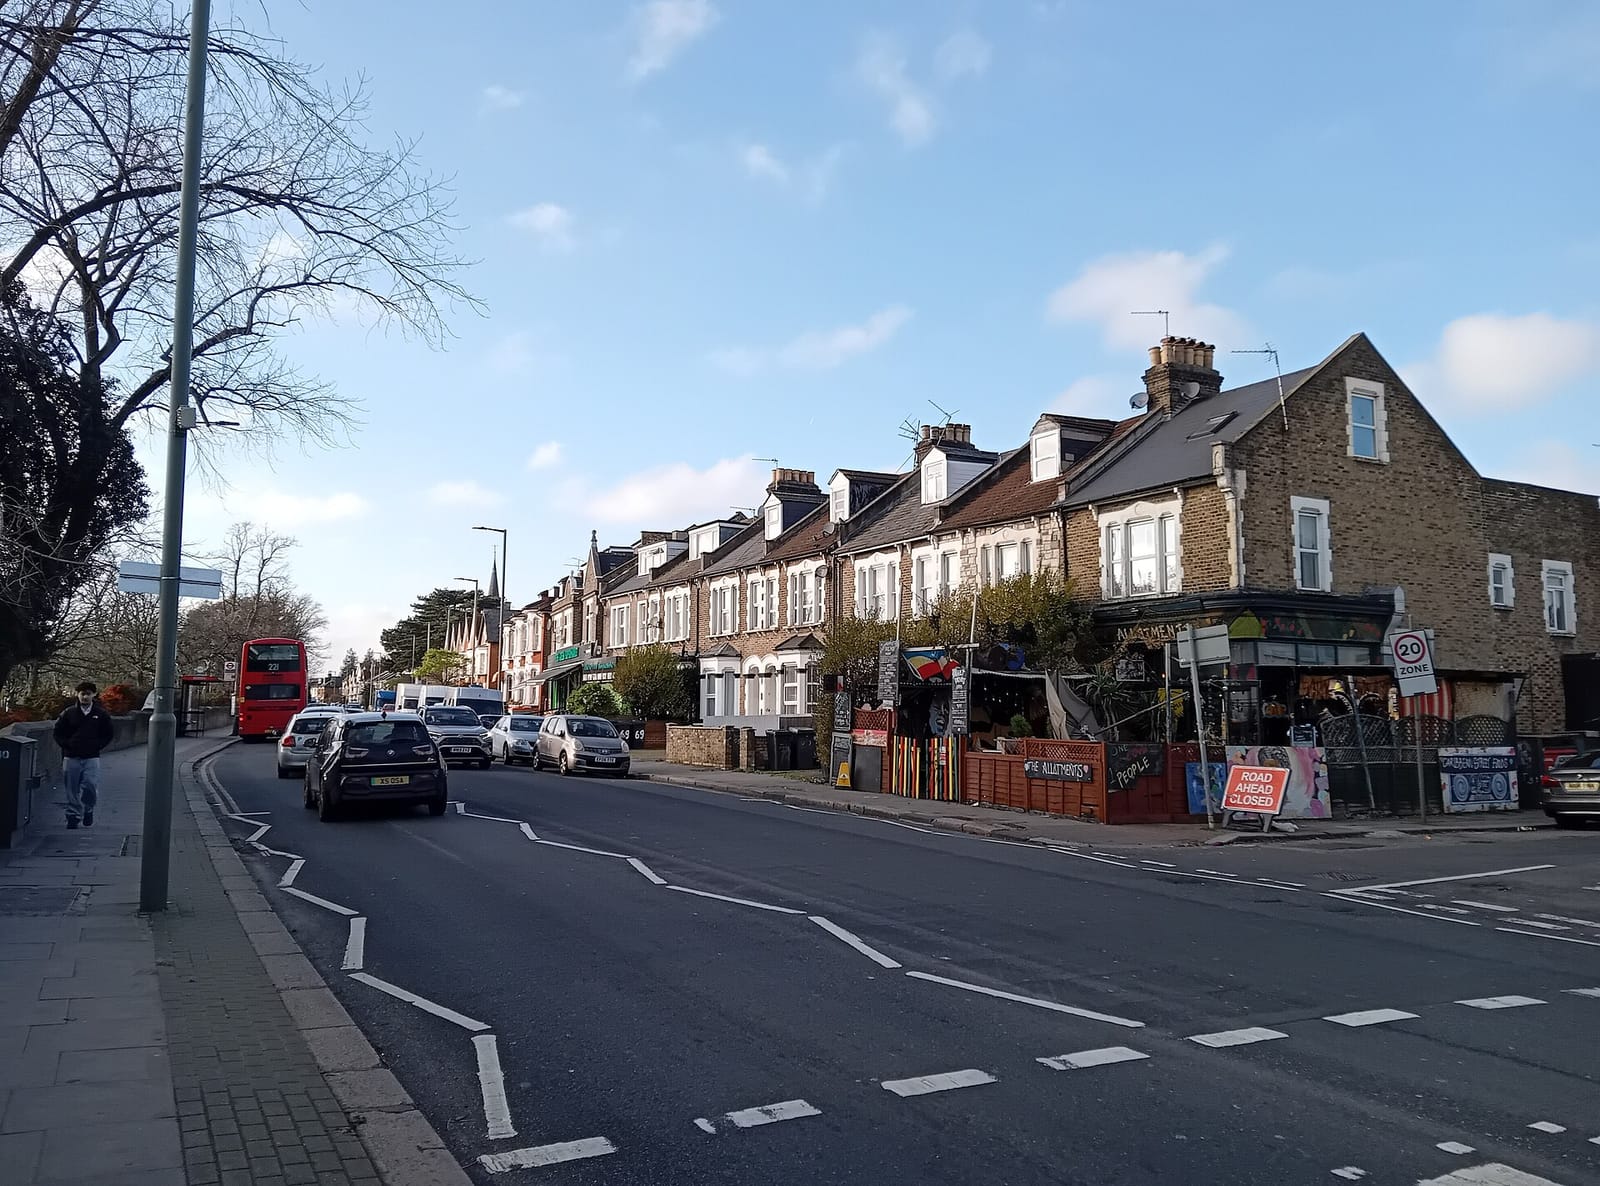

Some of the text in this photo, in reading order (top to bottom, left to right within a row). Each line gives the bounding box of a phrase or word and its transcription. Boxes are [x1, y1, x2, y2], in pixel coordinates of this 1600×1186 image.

[1399, 642, 1420, 656] 20
[268, 663, 279, 671] 221
[1399, 664, 1429, 674] ZONE
[635, 730, 645, 740] 69
[1112, 744, 1129, 757] ONE
[1027, 761, 1039, 772] THE
[1116, 756, 1150, 788] PEOPLE
[1241, 771, 1273, 783] ROAD
[1234, 782, 1274, 795] AHEAD
[1229, 793, 1274, 807] CLOSED
